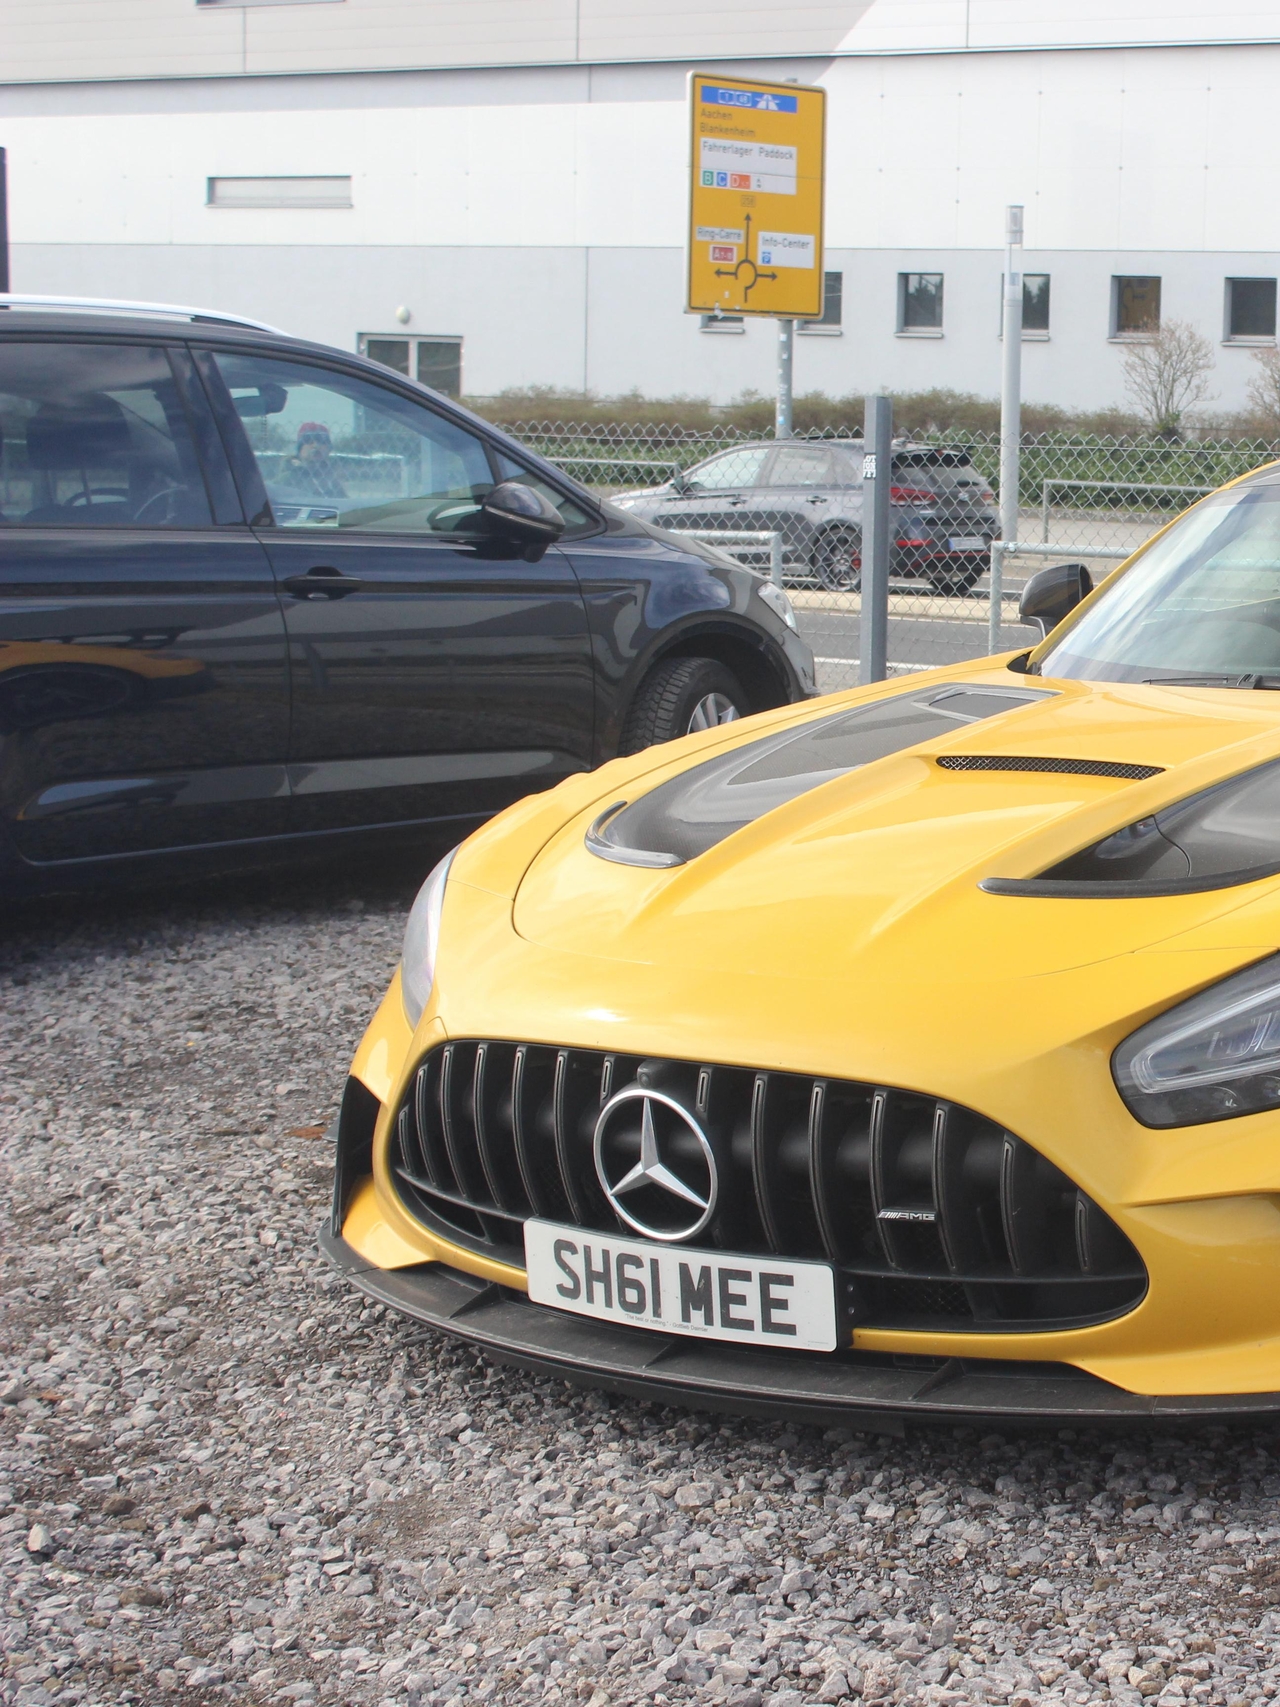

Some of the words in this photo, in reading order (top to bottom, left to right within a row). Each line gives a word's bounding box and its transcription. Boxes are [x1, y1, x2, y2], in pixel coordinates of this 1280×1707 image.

[701, 108, 733, 120] Aachen
[700, 122, 755, 137] Blankenheim
[702, 141, 753, 158] Fahrerlager
[758, 147, 794, 160] Paddock
[761, 236, 810, 250] Info-Center
[888, 1211, 935, 1220] AMG
[679, 1262, 797, 1336] MEE
